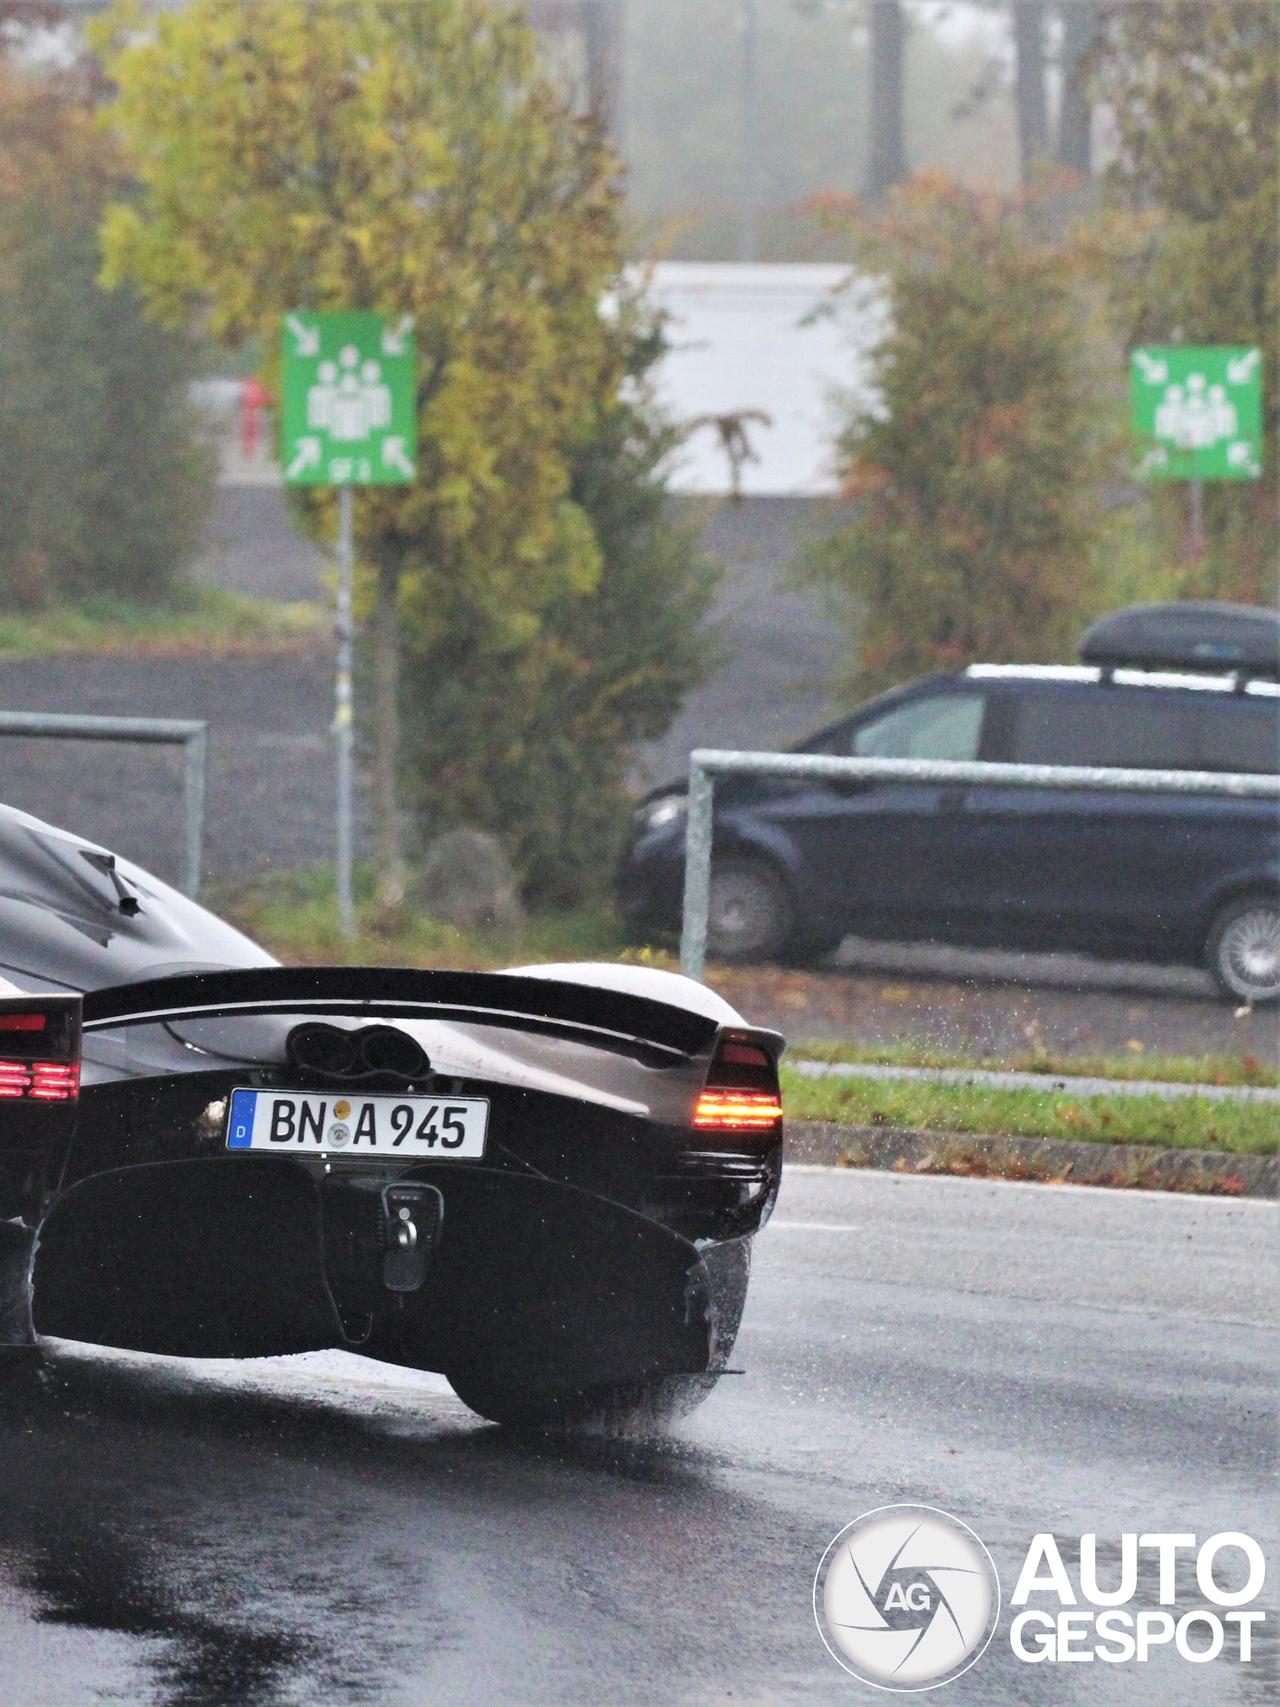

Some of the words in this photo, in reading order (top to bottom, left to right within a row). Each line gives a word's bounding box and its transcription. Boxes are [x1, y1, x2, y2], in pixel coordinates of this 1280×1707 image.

[236, 1126, 245, 1138] D
[270, 1100, 326, 1144] BN
[353, 1103, 376, 1146] A
[390, 1104, 468, 1149] 945
